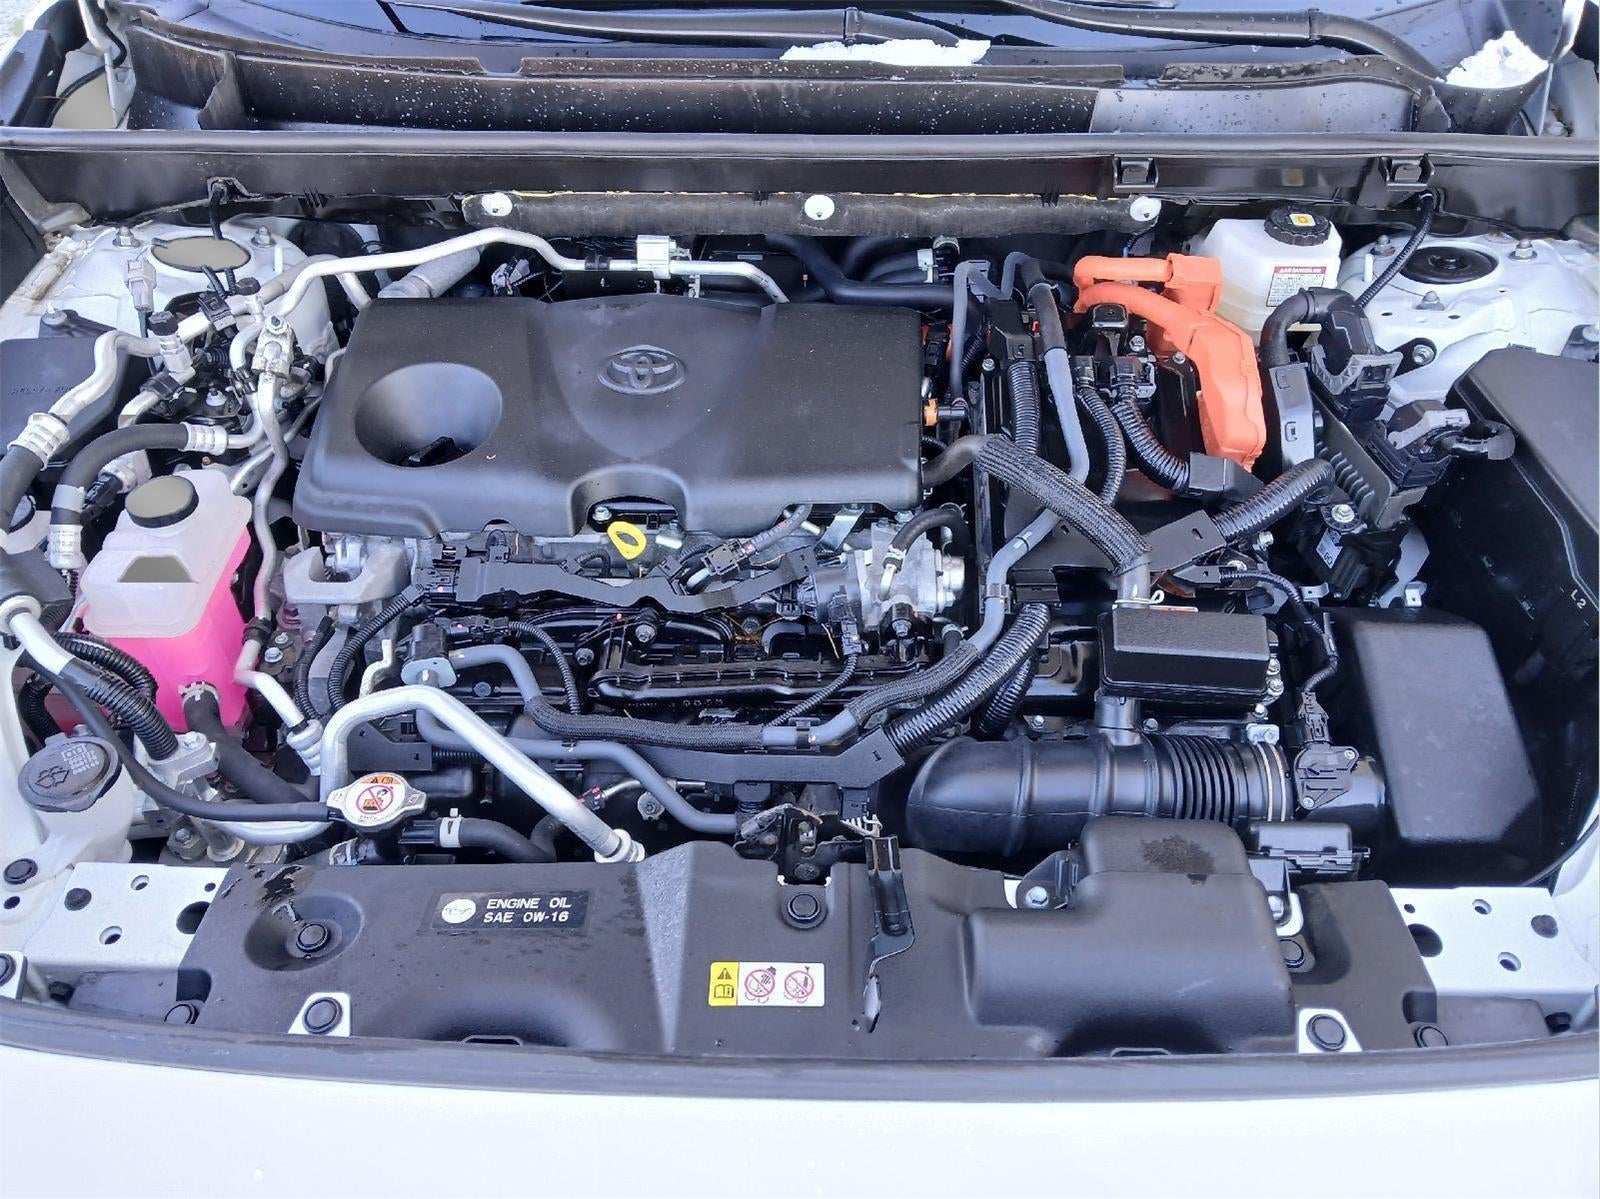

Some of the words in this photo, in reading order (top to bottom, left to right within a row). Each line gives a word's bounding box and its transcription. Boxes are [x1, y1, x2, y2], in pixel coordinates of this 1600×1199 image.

[486, 898, 541, 909] ENGINE
[549, 897, 572, 908] OIL
[483, 912, 514, 923] SAE
[523, 911, 569, 922] 0W-16
